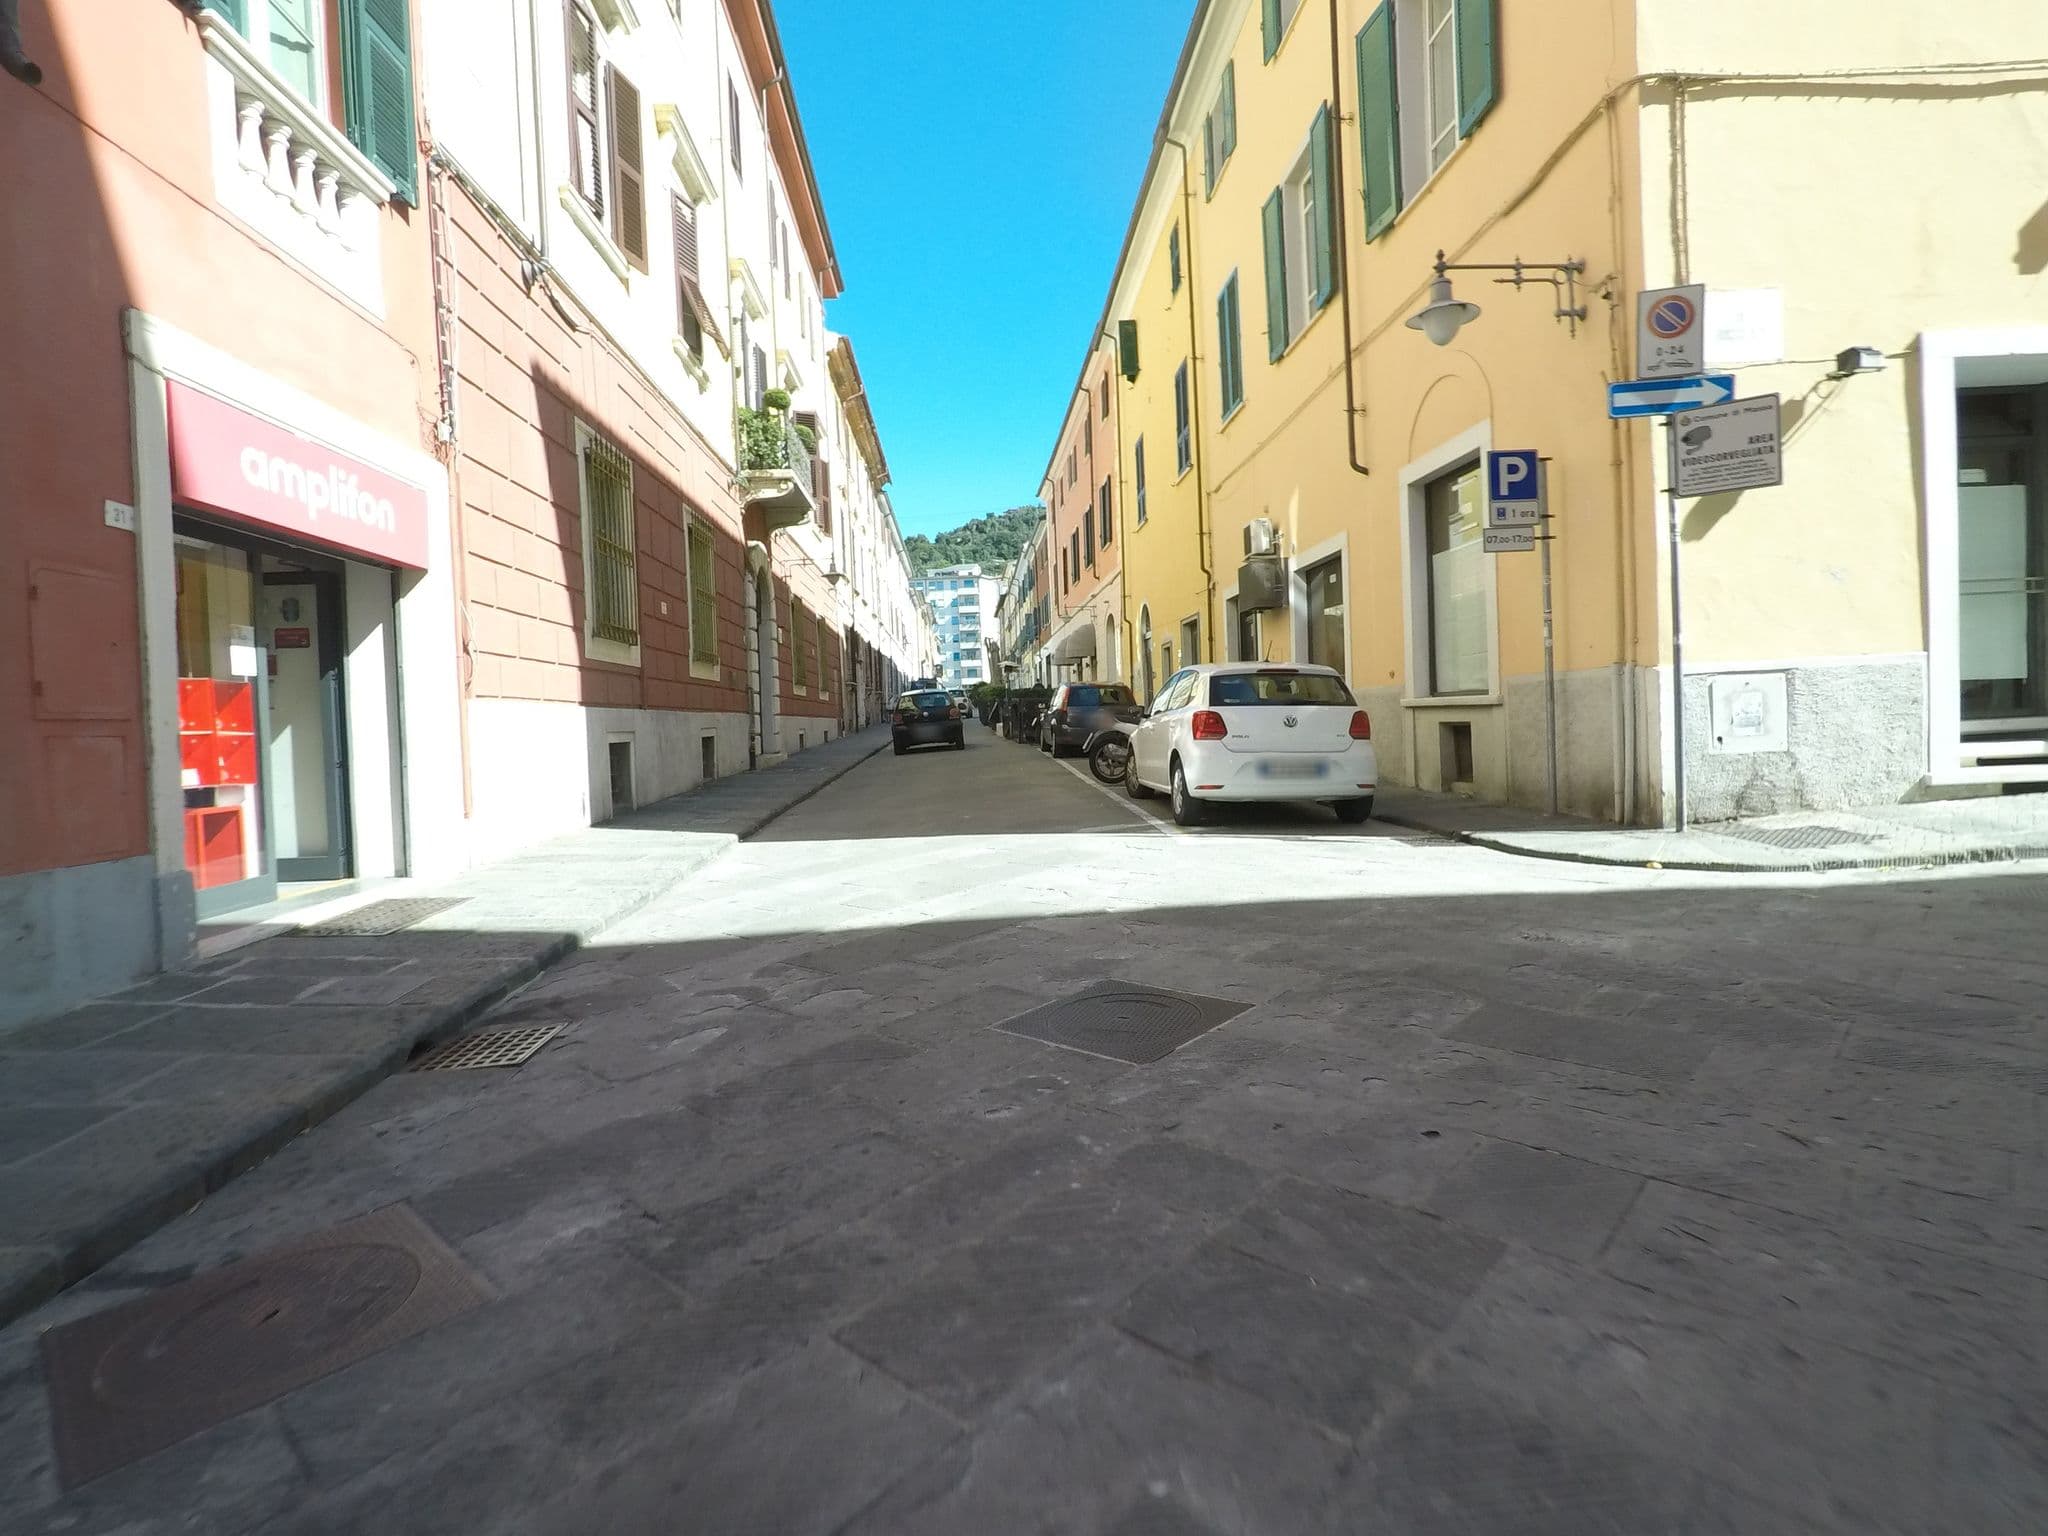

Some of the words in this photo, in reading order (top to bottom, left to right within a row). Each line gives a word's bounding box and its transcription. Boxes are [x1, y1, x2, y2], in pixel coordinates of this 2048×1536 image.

[1748, 433, 1774, 445] AREA
[1681, 445, 1775, 467] VIDEOSORVEGLIATA
[241, 447, 395, 532] amplifon
[1498, 456, 1528, 496] P
